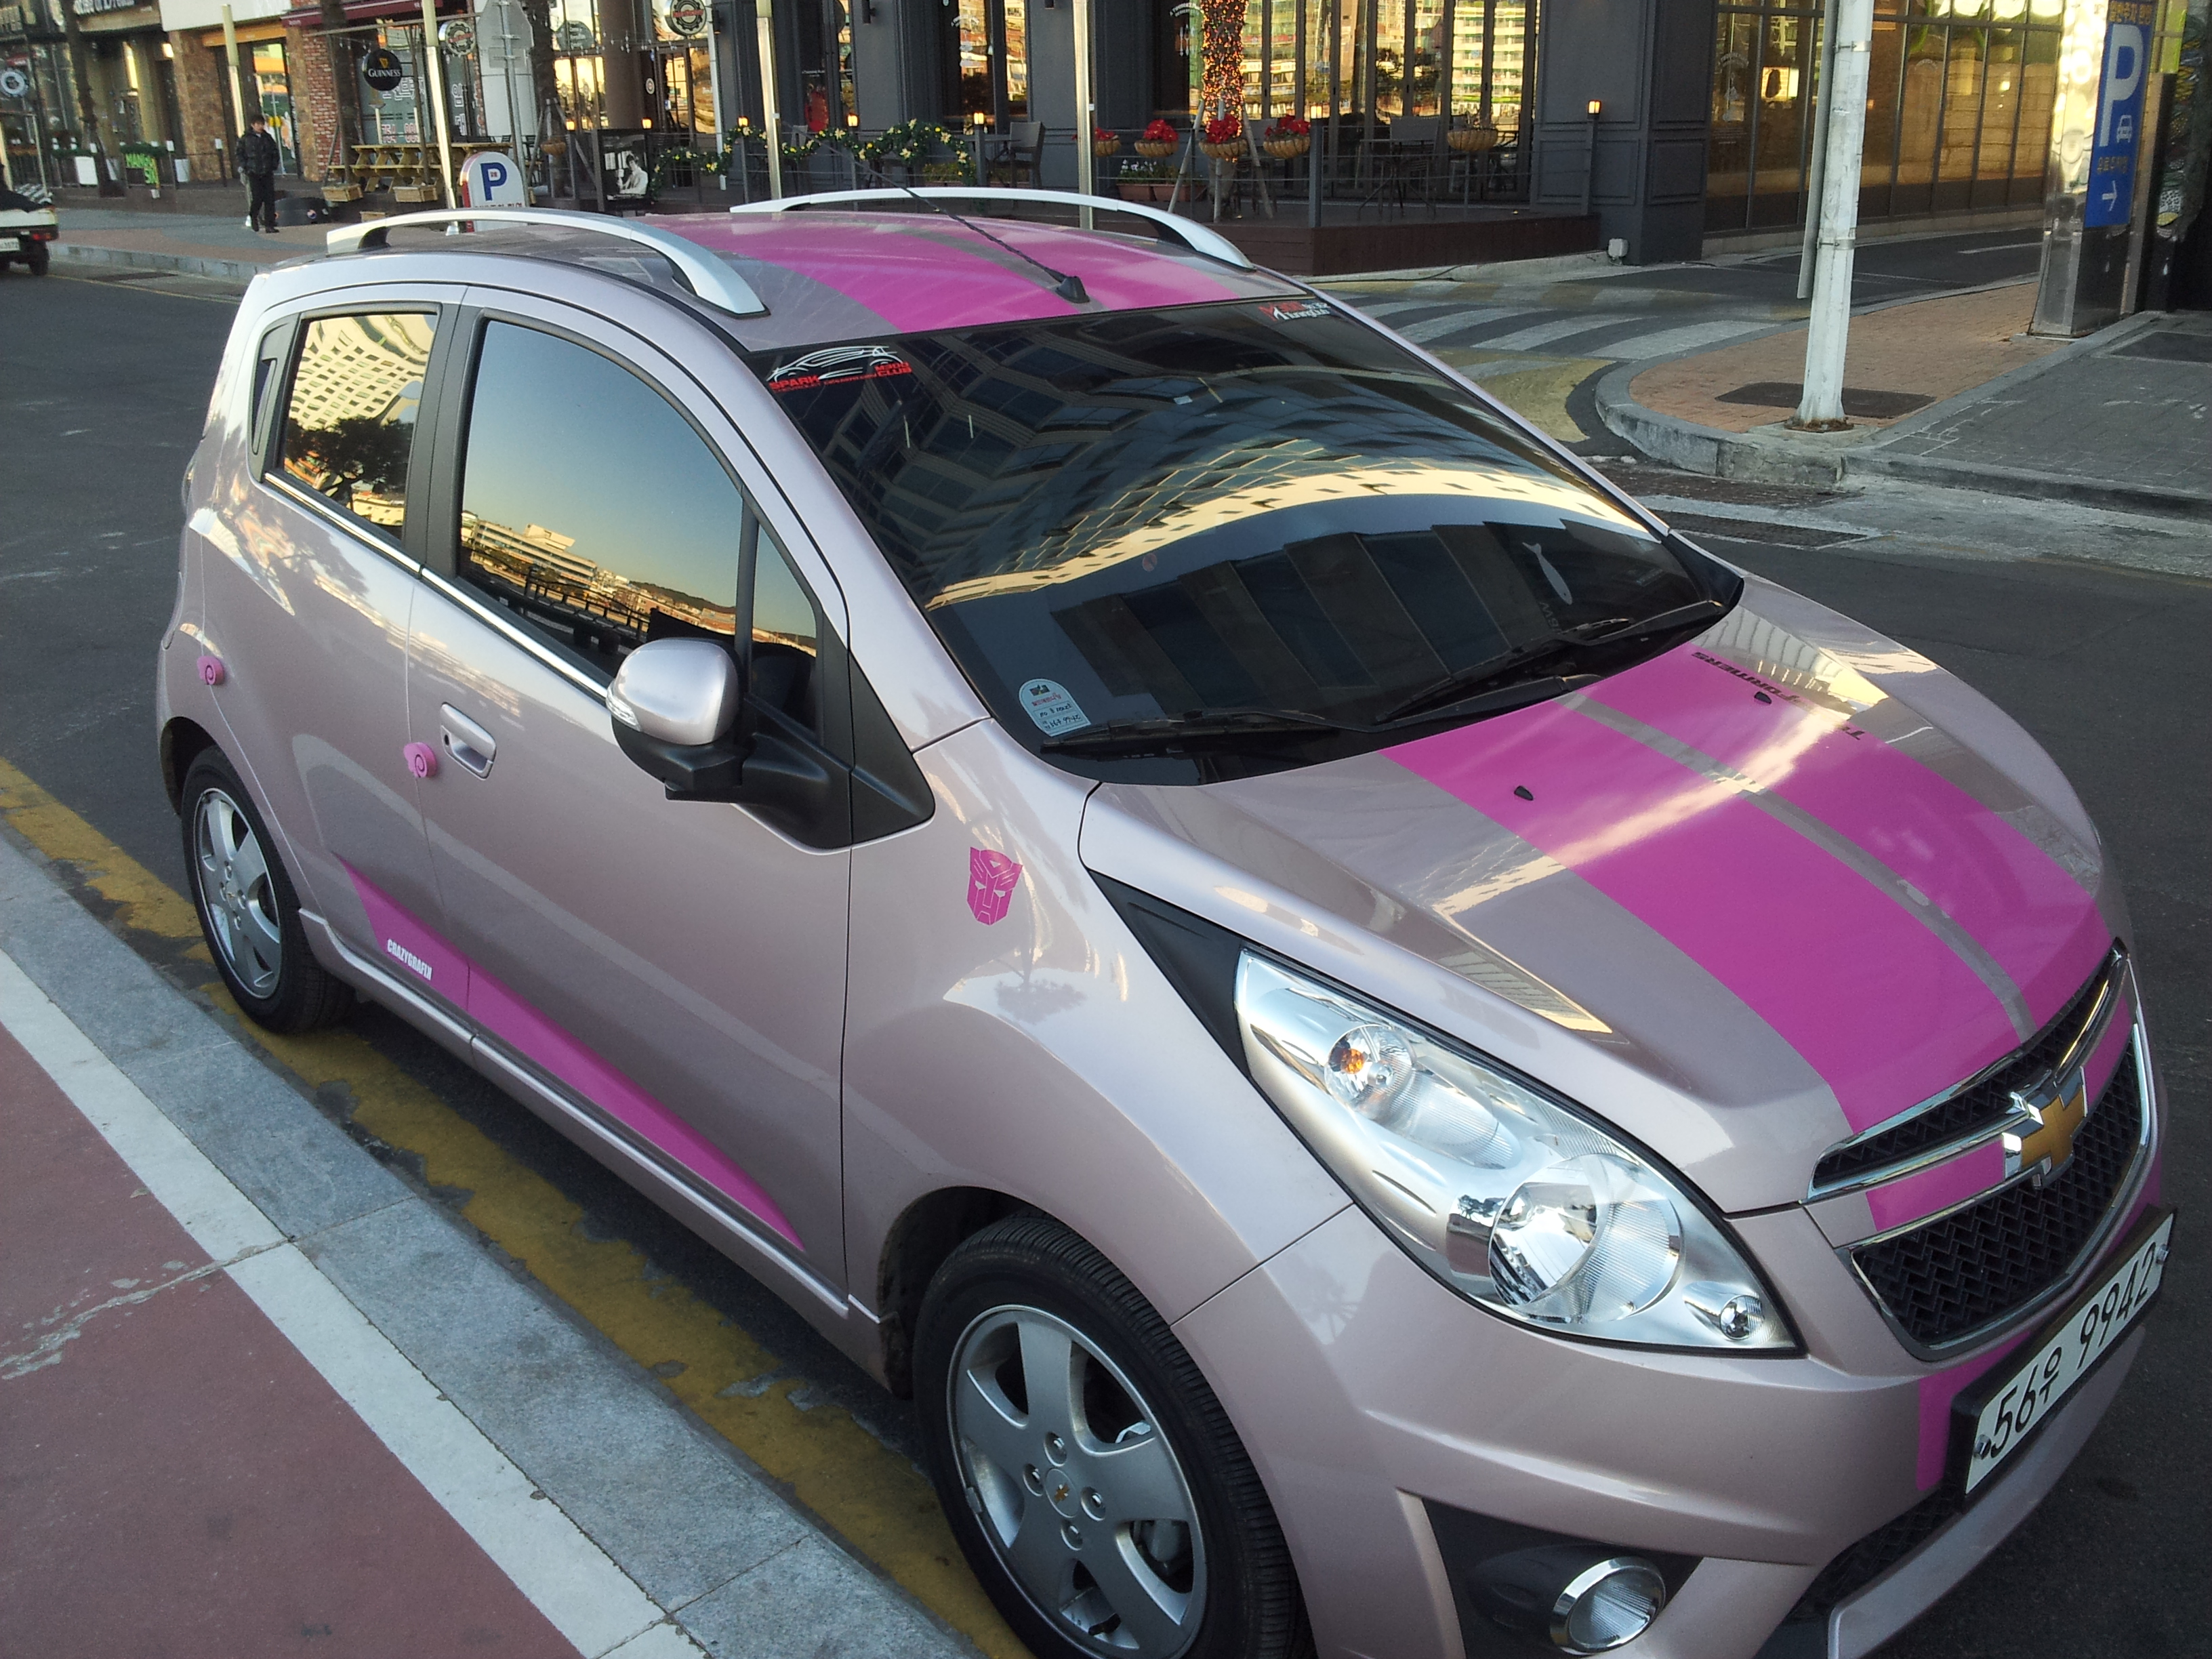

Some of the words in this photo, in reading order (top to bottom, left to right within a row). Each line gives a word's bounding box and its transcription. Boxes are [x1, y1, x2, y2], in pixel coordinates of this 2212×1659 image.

[368, 69, 401, 78] GUINNESS
[2100, 24, 2144, 147] P
[480, 162, 508, 201] P
[769, 375, 820, 390] SPARK
[877, 367, 913, 377] CLUB
[387, 939, 434, 981] CRAZYGRAFIX
[1990, 1346, 2063, 1459] 56우
[2077, 1242, 2158, 1370] 9942
